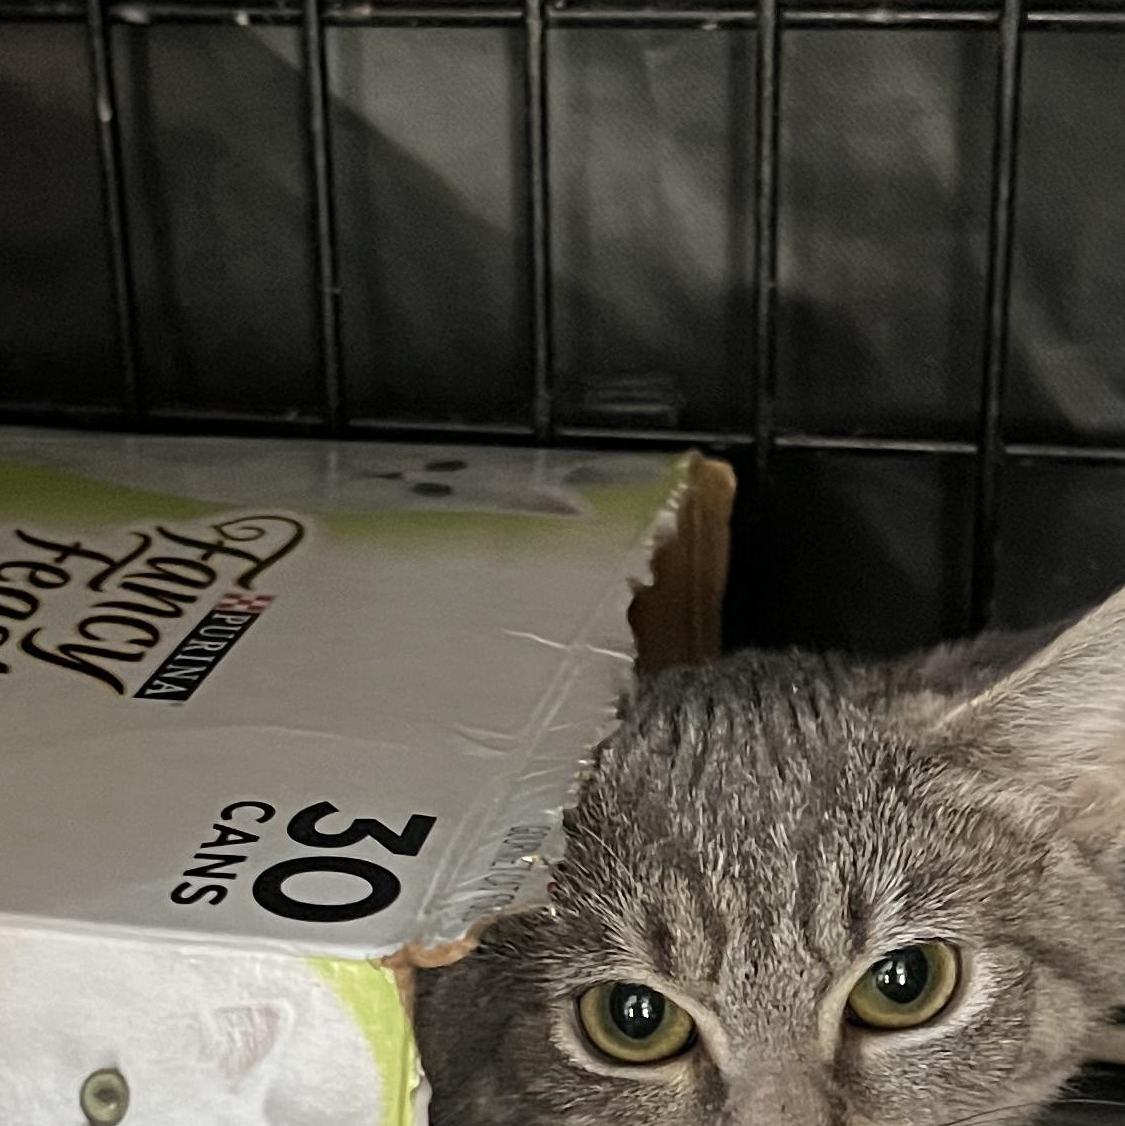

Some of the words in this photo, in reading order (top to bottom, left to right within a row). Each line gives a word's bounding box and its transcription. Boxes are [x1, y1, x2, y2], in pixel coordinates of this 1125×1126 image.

[19, 515, 304, 695] Fancy
[145, 613, 250, 695] PURINA
[171, 801, 276, 905] CANS
[252, 801, 437, 922] 30
